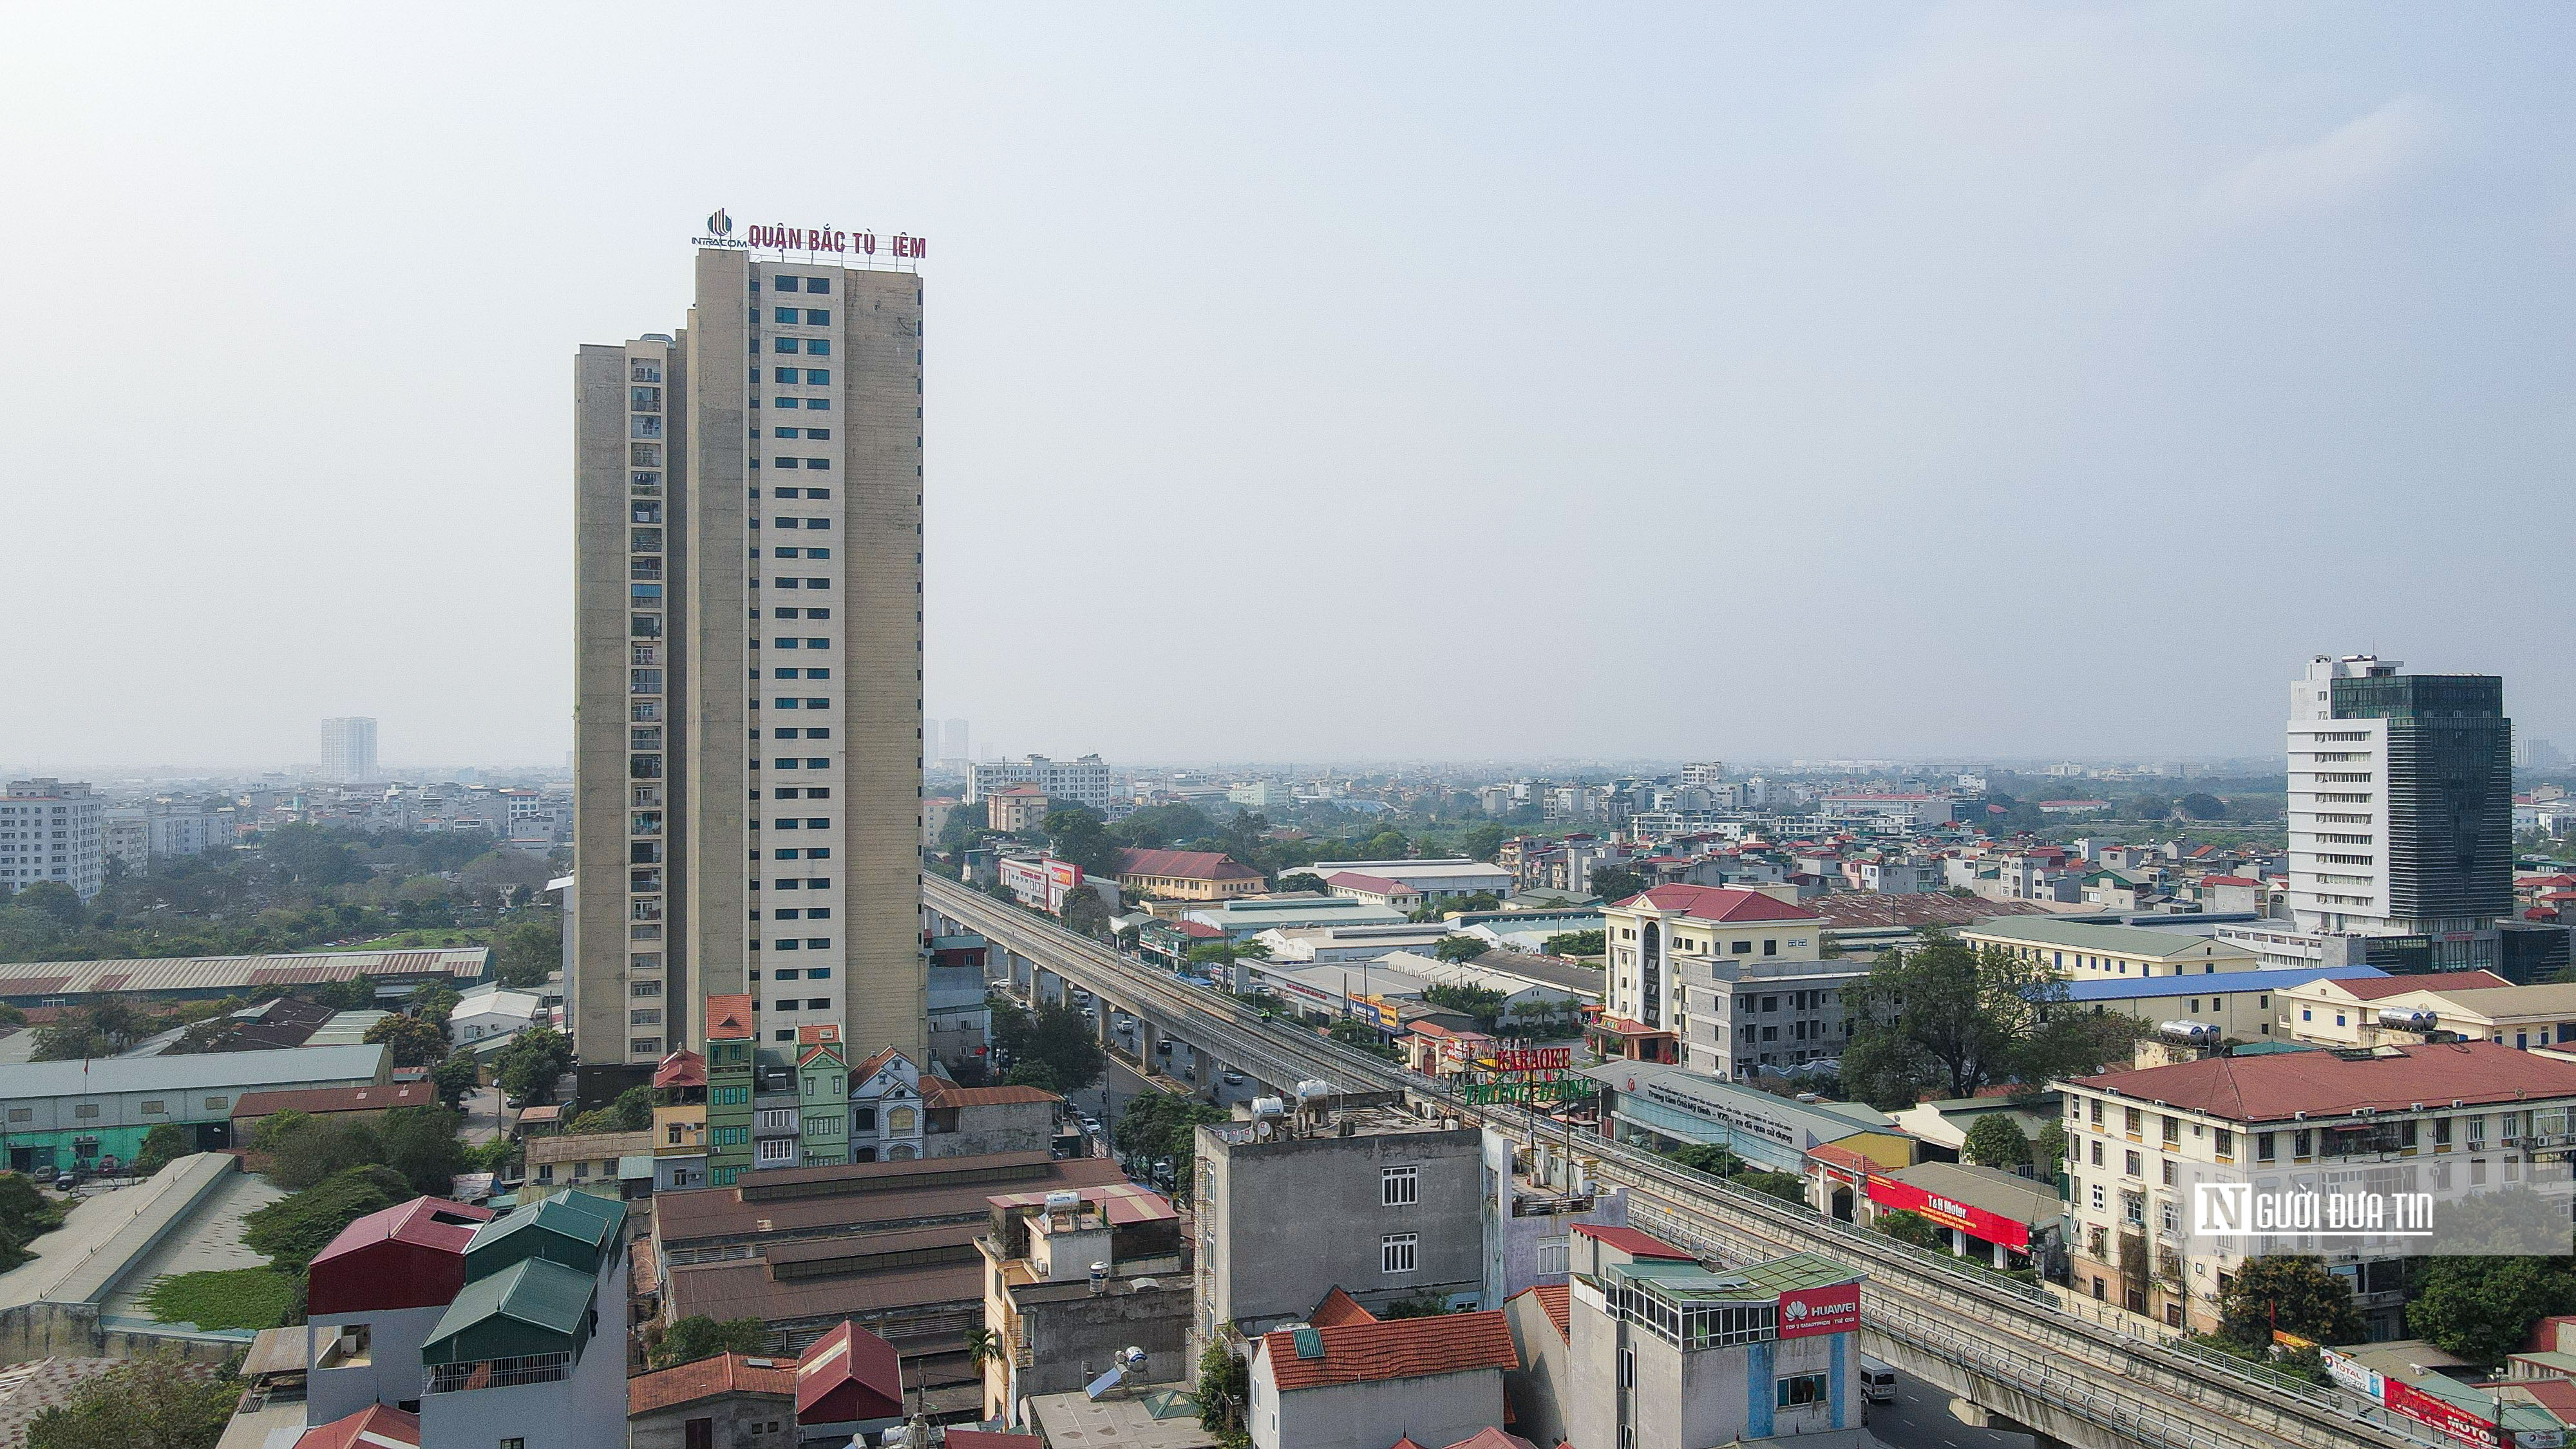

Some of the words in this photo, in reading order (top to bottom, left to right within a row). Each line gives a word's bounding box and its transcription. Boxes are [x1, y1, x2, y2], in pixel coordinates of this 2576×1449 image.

[692, 237, 748, 249] INTRACOM
[748, 222, 801, 252] QUẬN
[809, 223, 845, 252] BẮC
[1497, 1048, 1570, 1072] KARAOKE
[1464, 1072, 1531, 1106] TRỐNG
[1647, 1090, 1665, 1103] Trung
[1753, 1124, 1765, 1133] qua
[1776, 1130, 1793, 1144] dụng
[1944, 1200, 1967, 1219] Motor
[1812, 1302, 1855, 1316] HUAWEI
[2334, 1361, 2362, 1379] TOTAL
